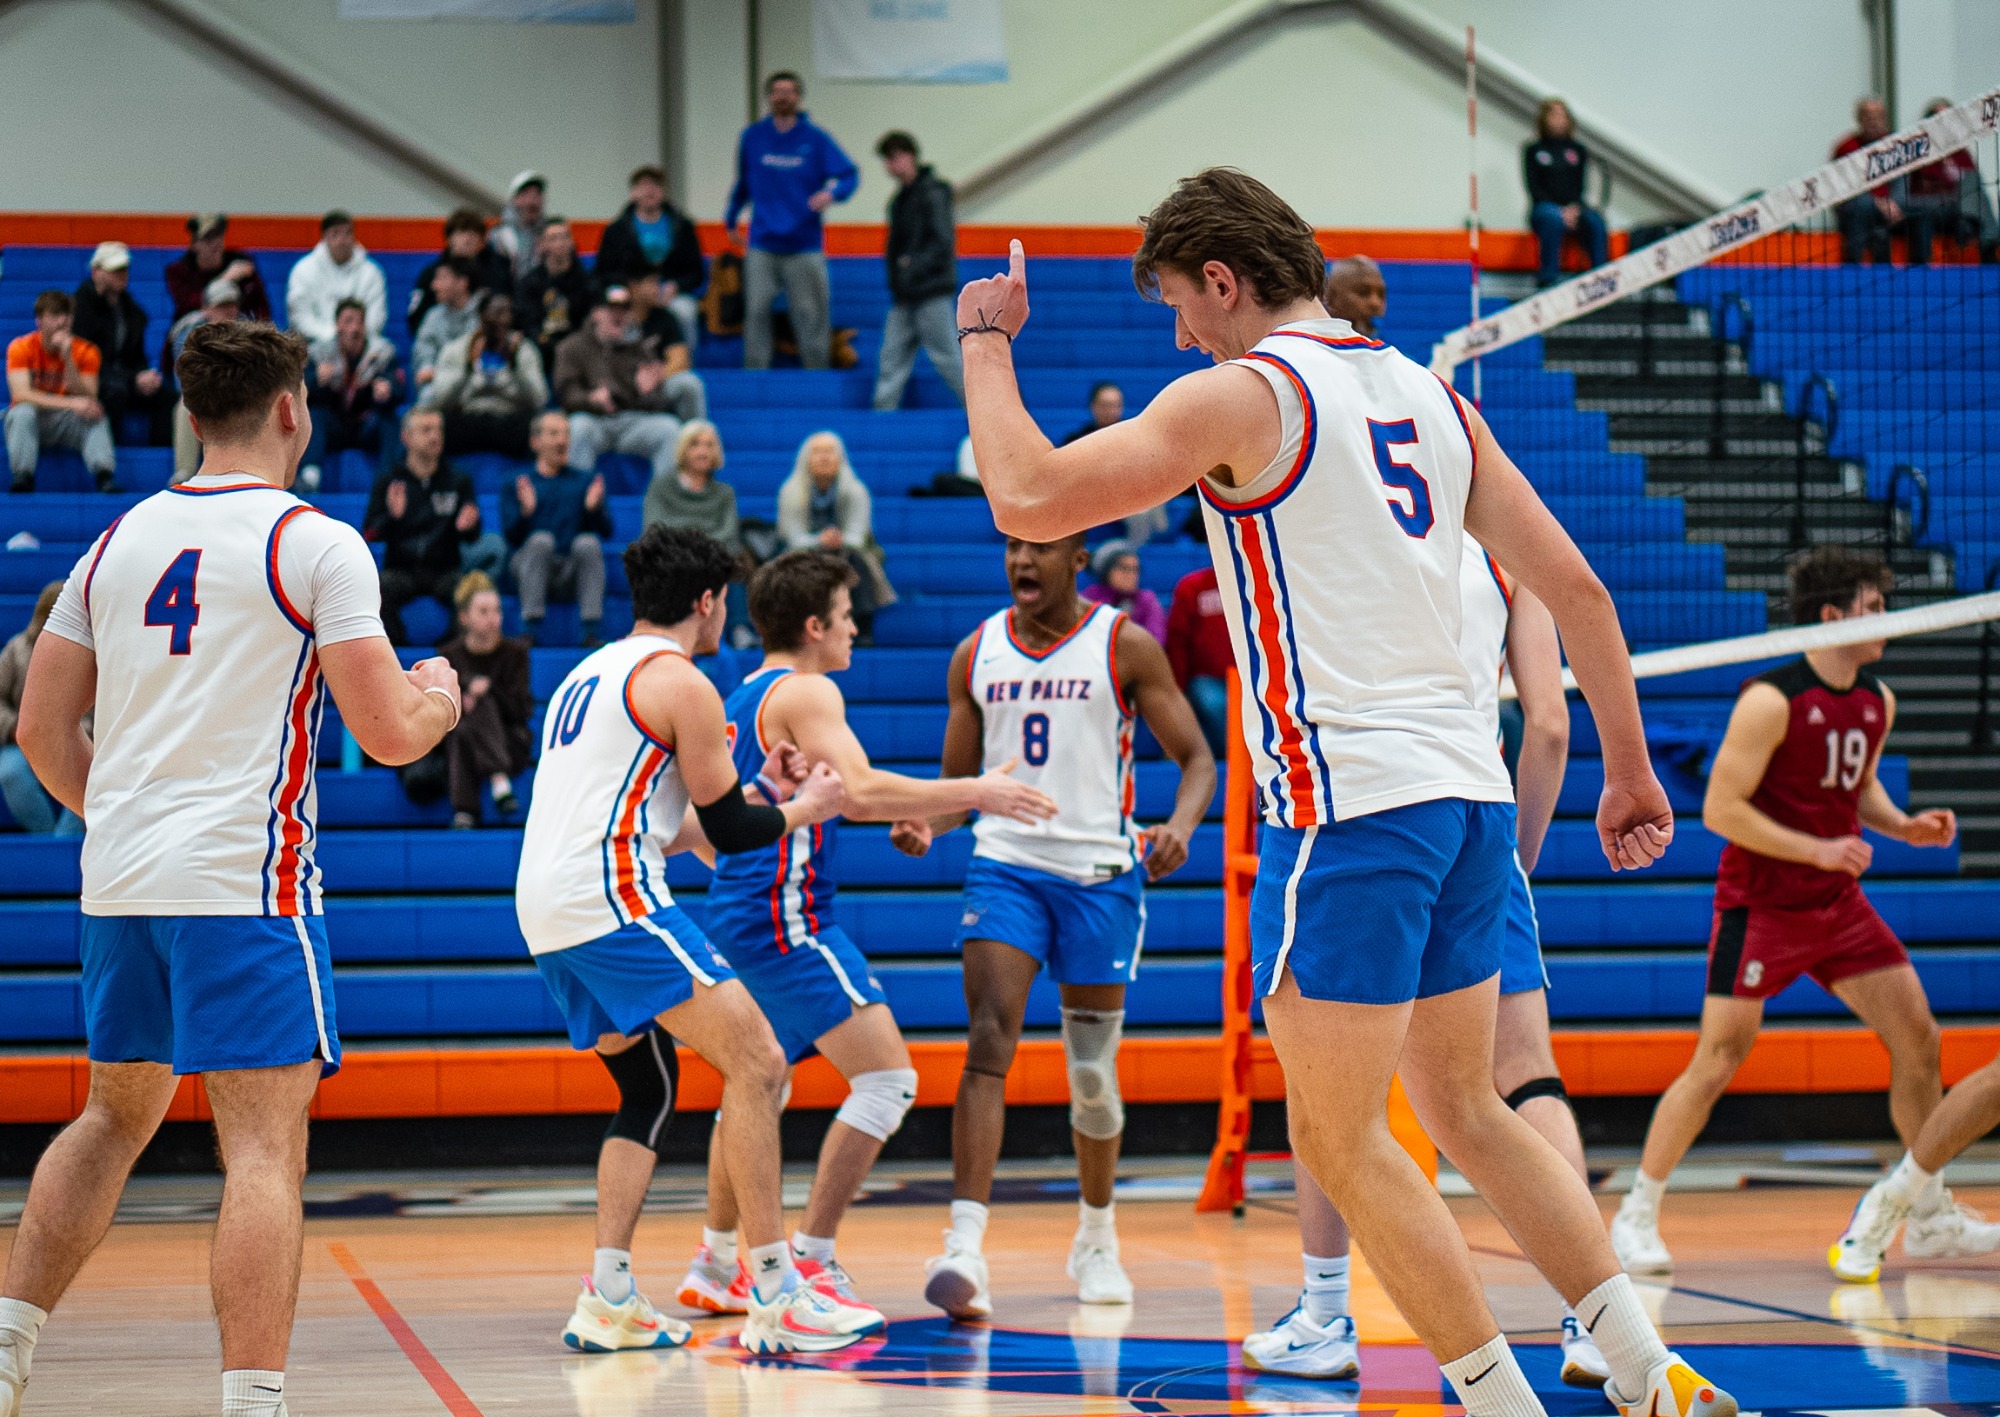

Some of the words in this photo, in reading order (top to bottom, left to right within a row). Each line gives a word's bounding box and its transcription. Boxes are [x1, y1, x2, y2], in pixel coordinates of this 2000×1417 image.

[1366, 417, 1435, 539] 5
[144, 548, 203, 655] 4
[548, 674, 600, 750] 10
[986, 681, 1022, 703] NEW
[1030, 679, 1091, 701] PALTZ
[1022, 711, 1050, 768] 8
[1819, 728, 1868, 791] 19
